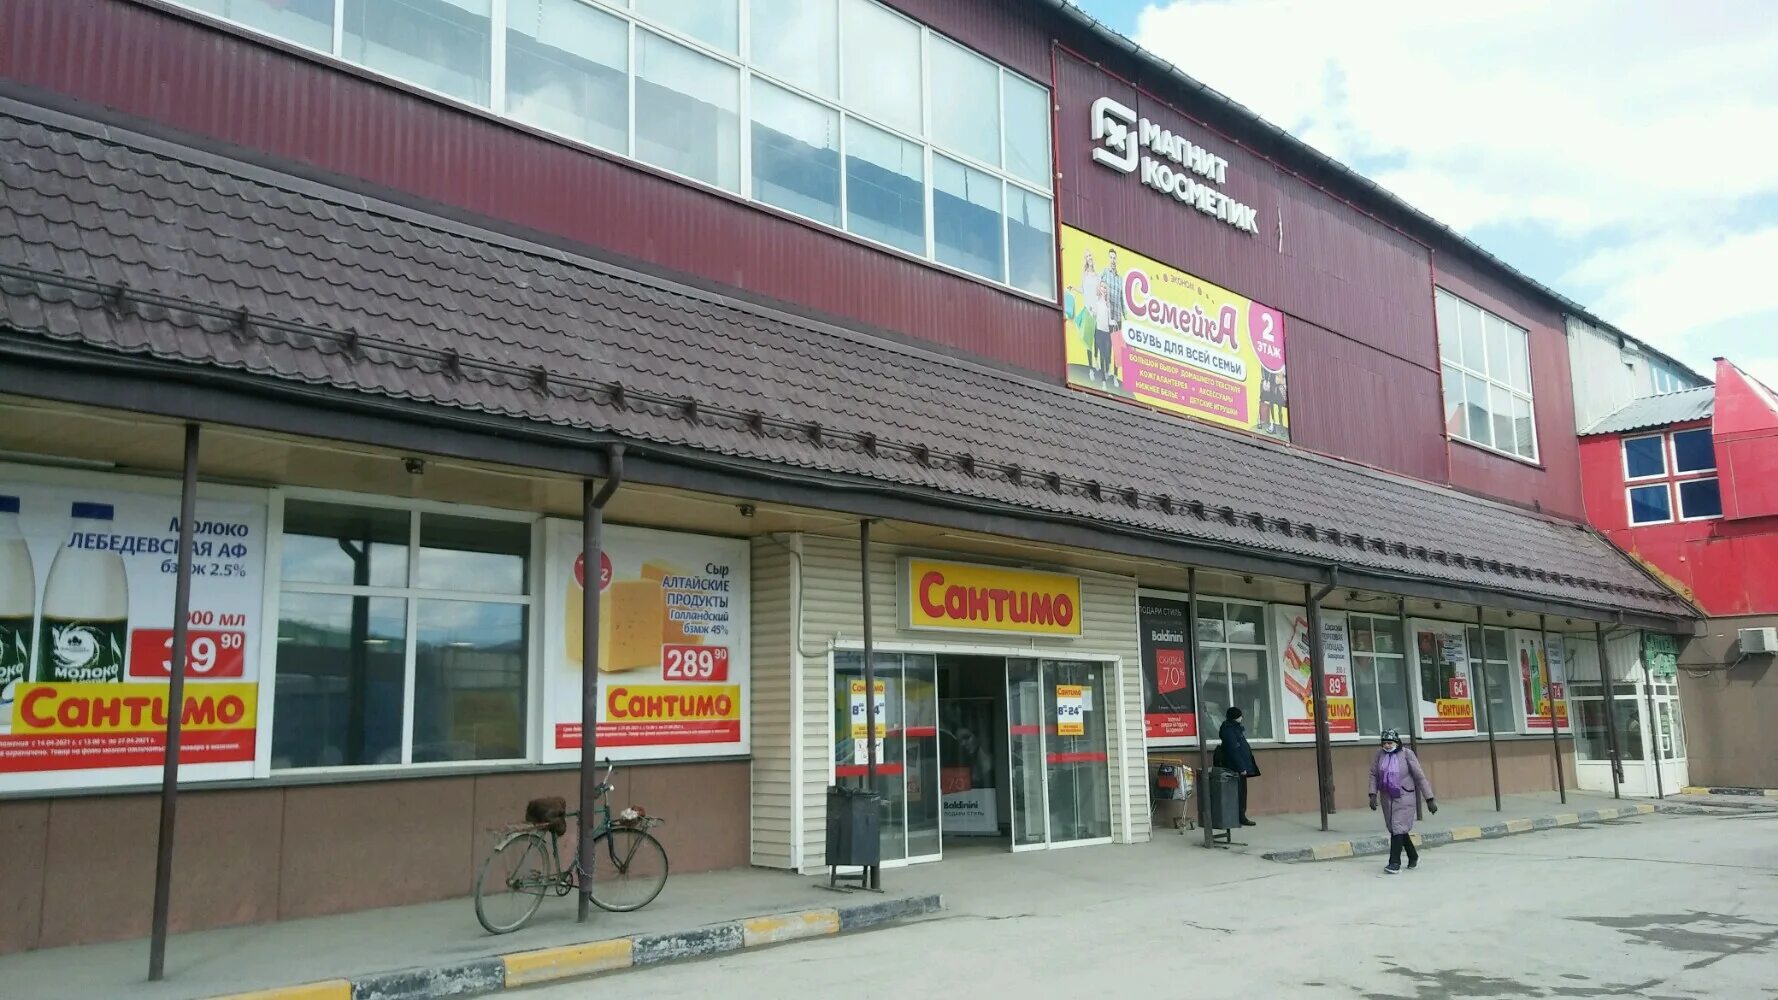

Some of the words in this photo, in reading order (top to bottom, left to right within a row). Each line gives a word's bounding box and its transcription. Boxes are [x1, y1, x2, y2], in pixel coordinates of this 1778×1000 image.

[1139, 118, 1228, 184] МАГНИТ
[1141, 156, 1259, 234] КОСМЕТИК
[1261, 312, 1275, 342] 2
[1128, 328, 1161, 348] ОБУВЬ
[1164, 340, 1184, 357] ДЛЯ
[1186, 346, 1211, 365] ВСЕЙ
[1213, 356, 1242, 375] СЕМЬИ
[1256, 341, 1281, 359] ЭТАЖ
[218, 542, 248, 558] АФ
[160, 559, 206, 575] бзж
[210, 562, 246, 577] 2.5%
[705, 562, 729, 578] Сыр
[662, 575, 730, 592] АЛТАЙСКИЕ
[667, 593, 729, 608] ПРОДУКТЫ
[919, 571, 1073, 627] Сантимо
[671, 609, 729, 622] Голландский
[1163, 607, 1182, 617] СТИЛЬ
[684, 623, 709, 634] бзмж
[711, 624, 729, 635] 45%
[1151, 629, 1184, 643] Baldinini
[220, 633, 242, 649] 90
[666, 650, 713, 677] 289
[714, 648, 727, 660] 90
[1057, 687, 1082, 696] Сантимо
[1329, 678, 1340, 694] 89
[1454, 681, 1463, 695] 64
[20, 687, 245, 729] Сантимо
[608, 688, 732, 718] Сантимо
[1437, 701, 1471, 716] Сантимо
[944, 800, 979, 809] Baldinini
